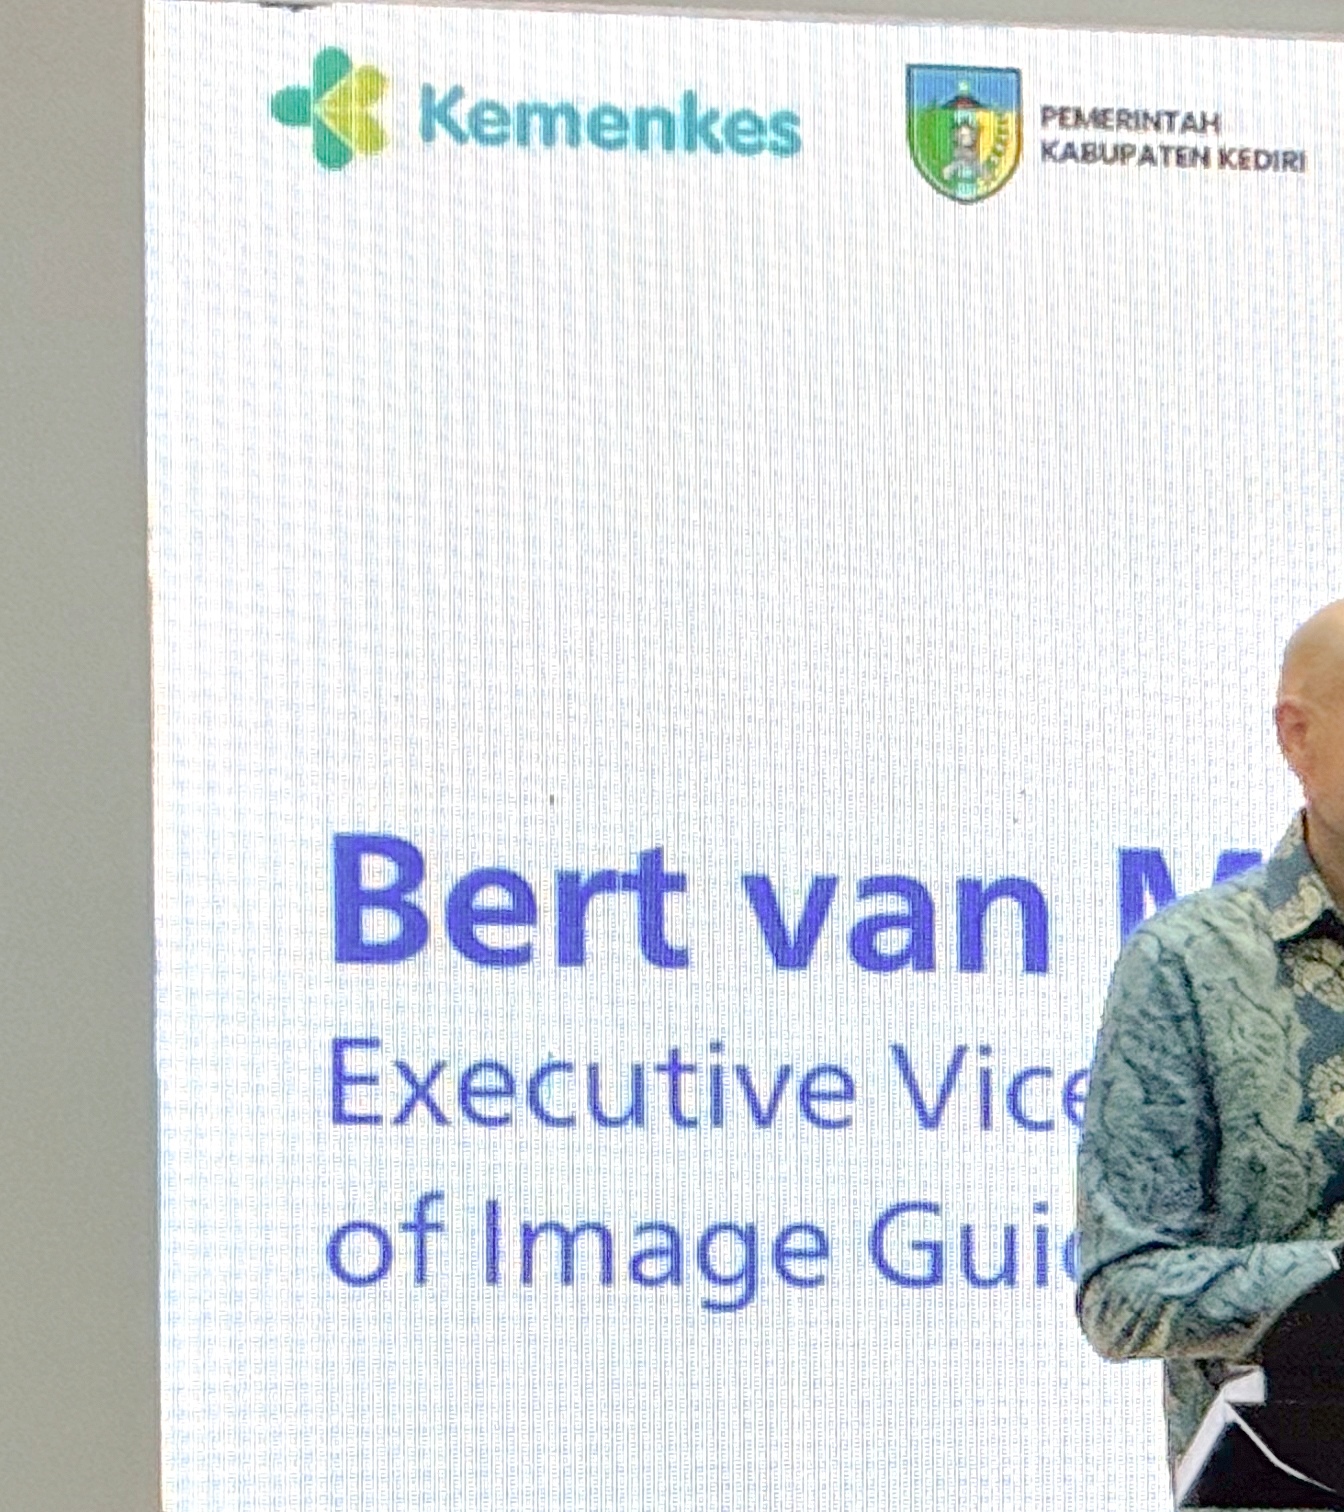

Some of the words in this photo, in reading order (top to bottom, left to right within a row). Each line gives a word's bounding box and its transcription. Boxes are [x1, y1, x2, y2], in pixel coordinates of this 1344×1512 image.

[418, 85, 801, 158] Kemenkes
[1040, 104, 1221, 136] PEMERINTAH
[1040, 139, 1212, 170] KABUPATEN
[1216, 147, 1309, 172] KEDIRI
[331, 830, 690, 971] Bert
[740, 872, 1050, 977] van
[330, 1036, 856, 1131] Executive
[325, 1190, 445, 1288] of
[485, 1199, 831, 1314] Image
[867, 1199, 1081, 1289] Gui
